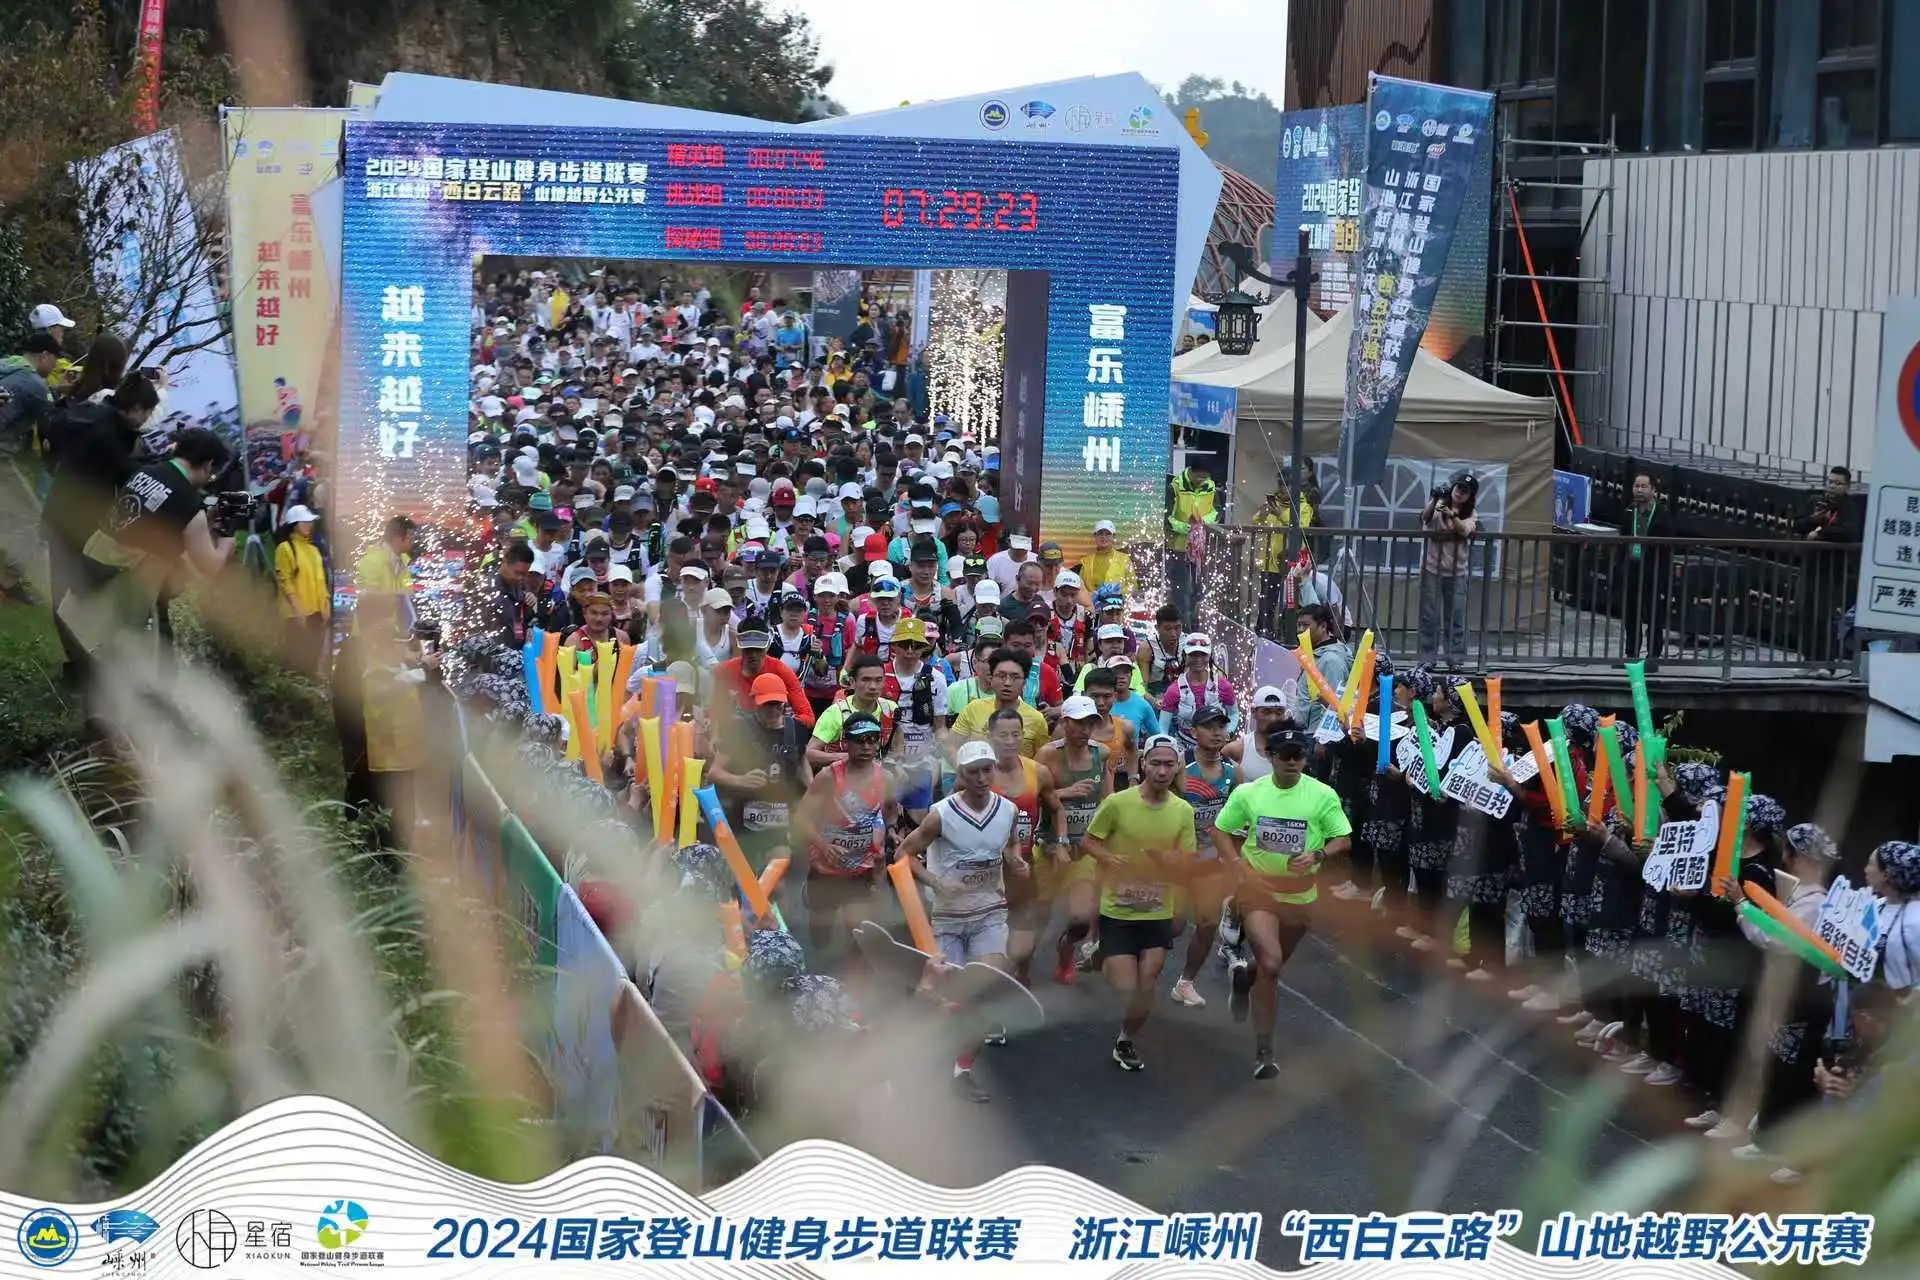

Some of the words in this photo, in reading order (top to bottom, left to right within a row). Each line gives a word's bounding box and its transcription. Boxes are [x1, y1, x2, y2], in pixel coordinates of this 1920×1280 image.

[366, 157, 649, 185] 2024国家登山健身步道联赛
[883, 188, 1038, 232] 07:29:23
[256, 240, 281, 346] 越来越好
[380, 284, 425, 458] 越来越好
[1083, 304, 1127, 473] 富乐嵊州
[1875, 585, 1917, 608] 严禁
[1262, 831, 1299, 844] B0200
[1659, 824, 1697, 855] 坚持
[1667, 855, 1706, 887] 很酷
